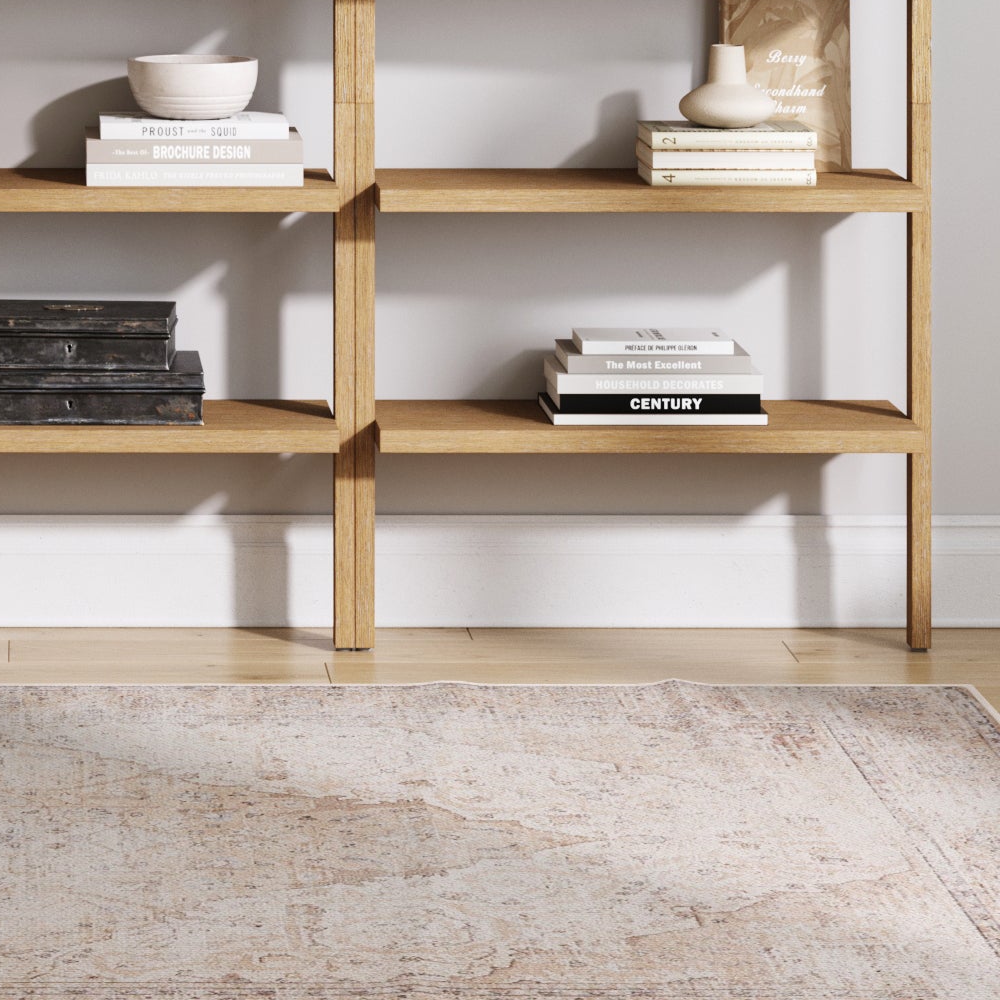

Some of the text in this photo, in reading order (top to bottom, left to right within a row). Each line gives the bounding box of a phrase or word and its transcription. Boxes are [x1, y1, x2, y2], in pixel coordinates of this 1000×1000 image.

[142, 126, 184, 137] PROUST
[210, 126, 237, 137] SQUID
[662, 136, 676, 146] 2
[152, 144, 210, 160] BROCHURE
[212, 144, 251, 160] DESIGN
[662, 173, 676, 183] 4
[605, 360, 702, 370] The Most Excellent
[595, 379, 724, 390] HOUSEHOLD DECORATES
[629, 397, 703, 410] CENTURY
